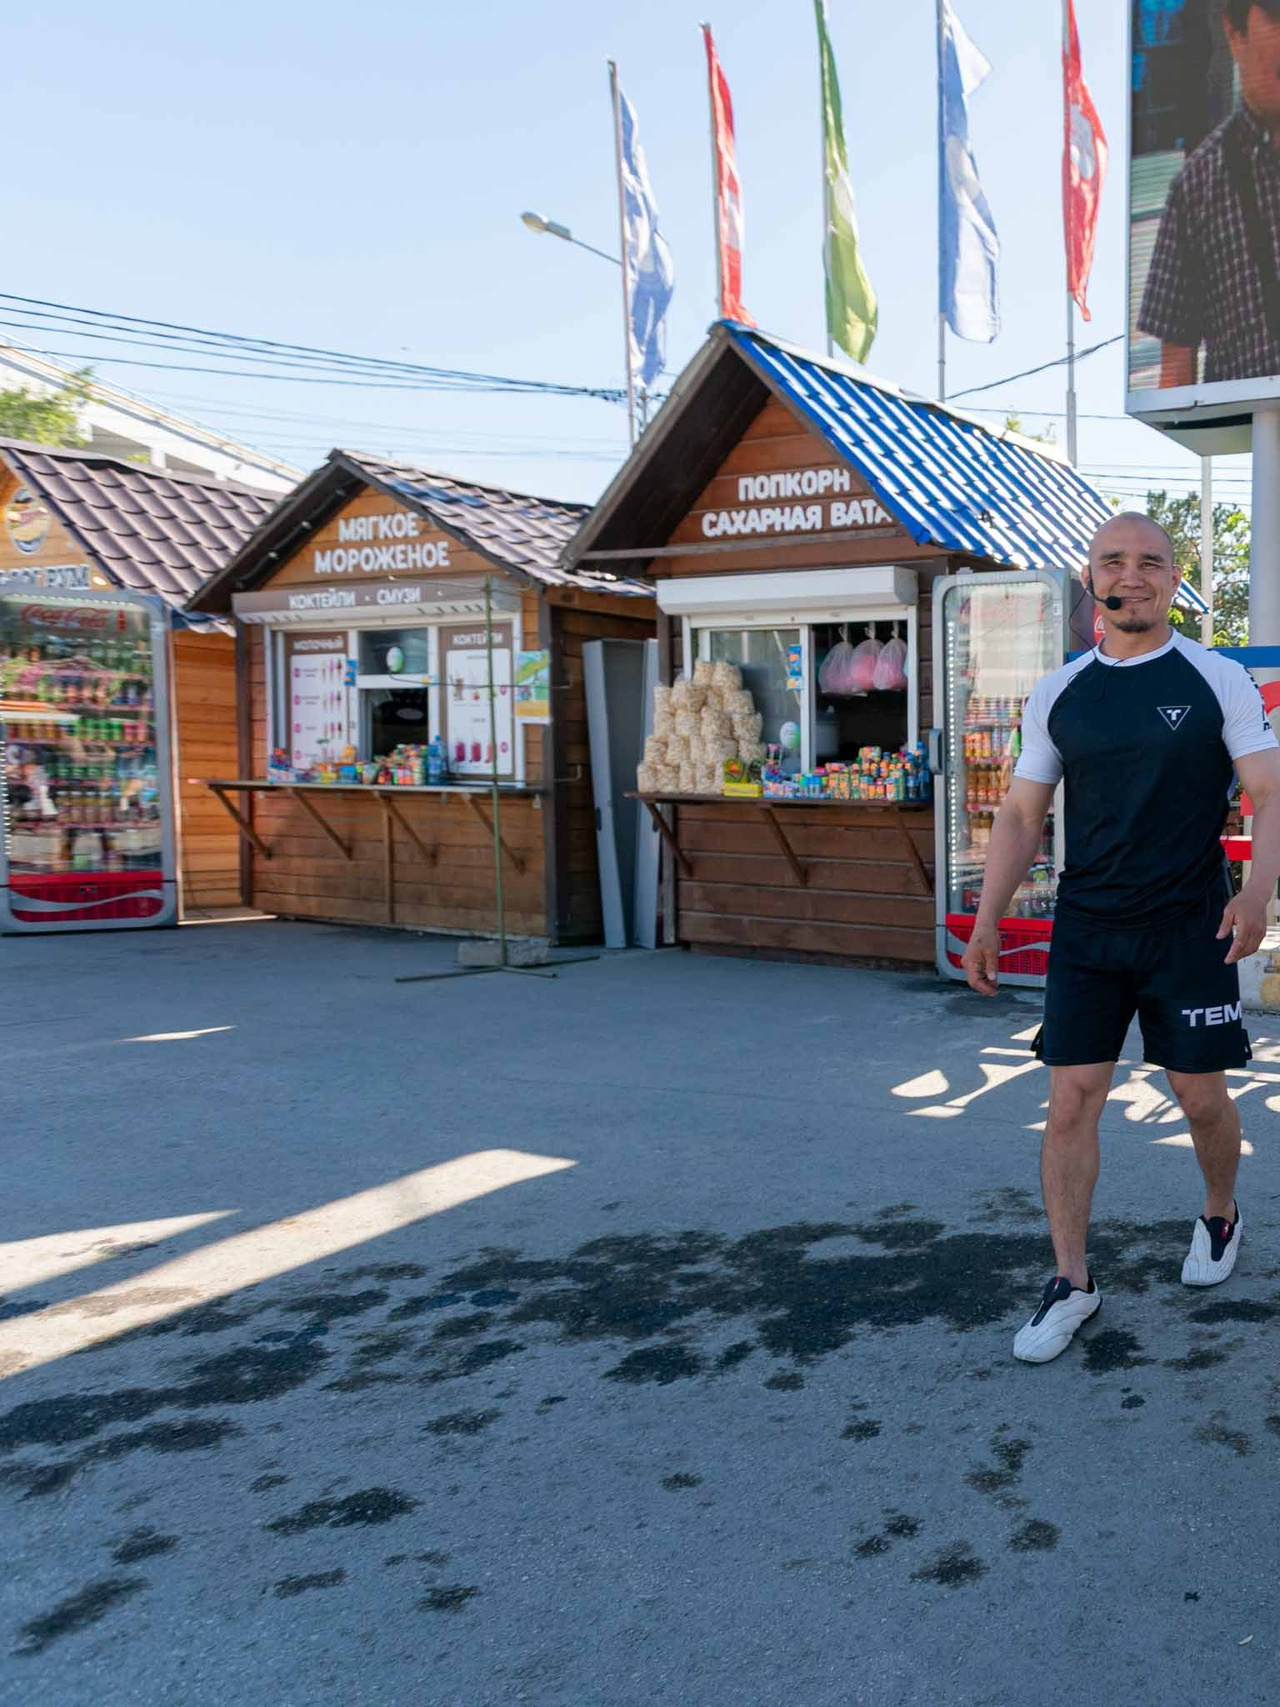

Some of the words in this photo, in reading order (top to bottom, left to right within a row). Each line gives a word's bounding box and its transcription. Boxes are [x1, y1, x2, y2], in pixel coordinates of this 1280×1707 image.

[738, 468, 850, 501] ПОПКОРН
[338, 512, 420, 542] МЯГКОЕ
[702, 505, 822, 538] САХАРНАЯ
[830, 499, 893, 526] ВАТА
[314, 542, 450, 573] МОРОЖЕНОЕ
[288, 587, 356, 610] КОКТЕЙЛИ
[377, 586, 421, 605] СМУЗИ
